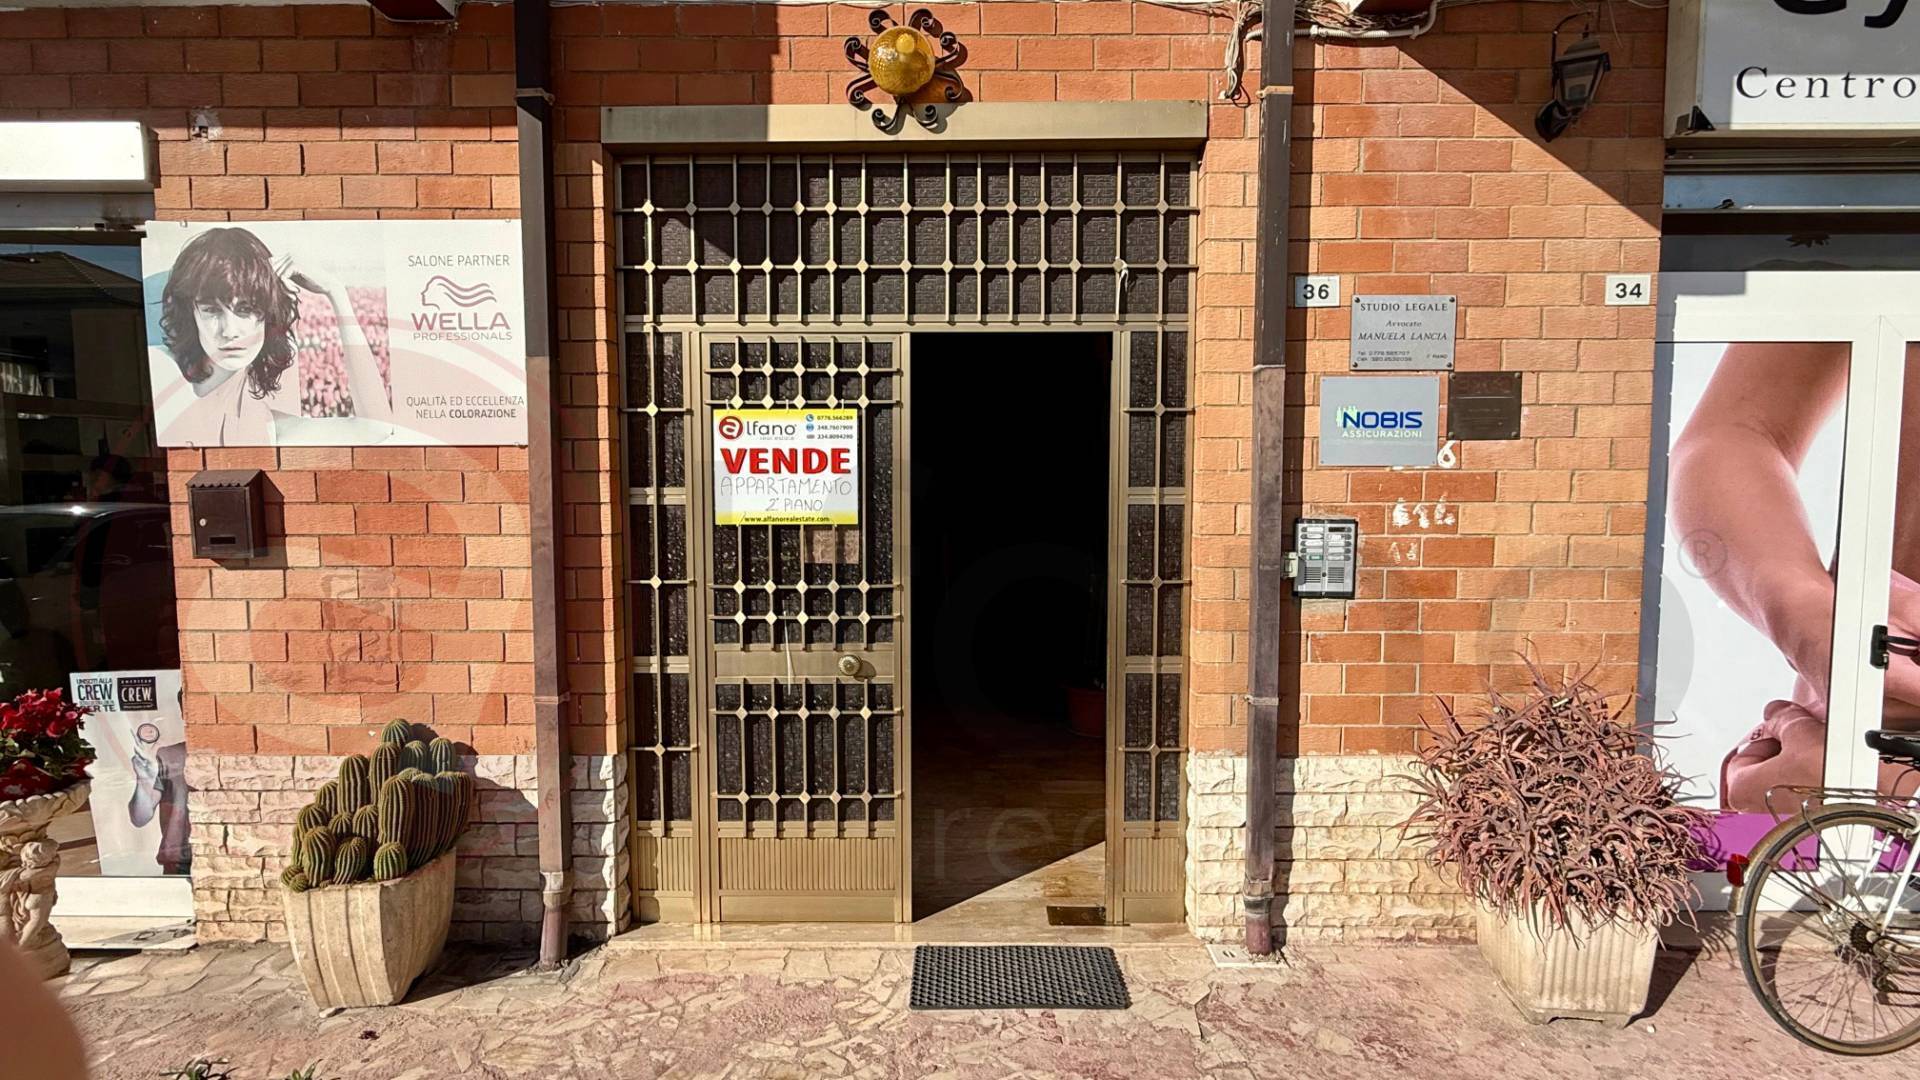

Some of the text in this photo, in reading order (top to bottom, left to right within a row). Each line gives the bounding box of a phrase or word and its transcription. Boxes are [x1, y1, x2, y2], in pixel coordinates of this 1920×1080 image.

[1736, 66, 1917, 99] Centro
[408, 254, 510, 267] SALONE PARTNER
[1303, 284, 1329, 300] 36
[1615, 282, 1642, 299] 34
[1360, 303, 1448, 312] STUDIO LEGALE
[411, 312, 511, 331] WELLA
[1385, 320, 1422, 328] Avvocato
[413, 331, 513, 341] PROFESSIONALS
[1358, 332, 1447, 341] MANUELA LANCIA
[406, 395, 524, 407] QUALITÀ ED ECCELLENZA
[416, 408, 517, 418] NELLA COLORAZIONE
[1343, 411, 1423, 429] NOBIS
[1342, 430, 1423, 438] ASSICURAZIONI
[720, 448, 851, 474] VENDE
[720, 476, 853, 496] APPARTAMENTO
[784, 499, 823, 512] PIANO
[78, 684, 112, 701] CREW
[121, 686, 153, 702] CREW
